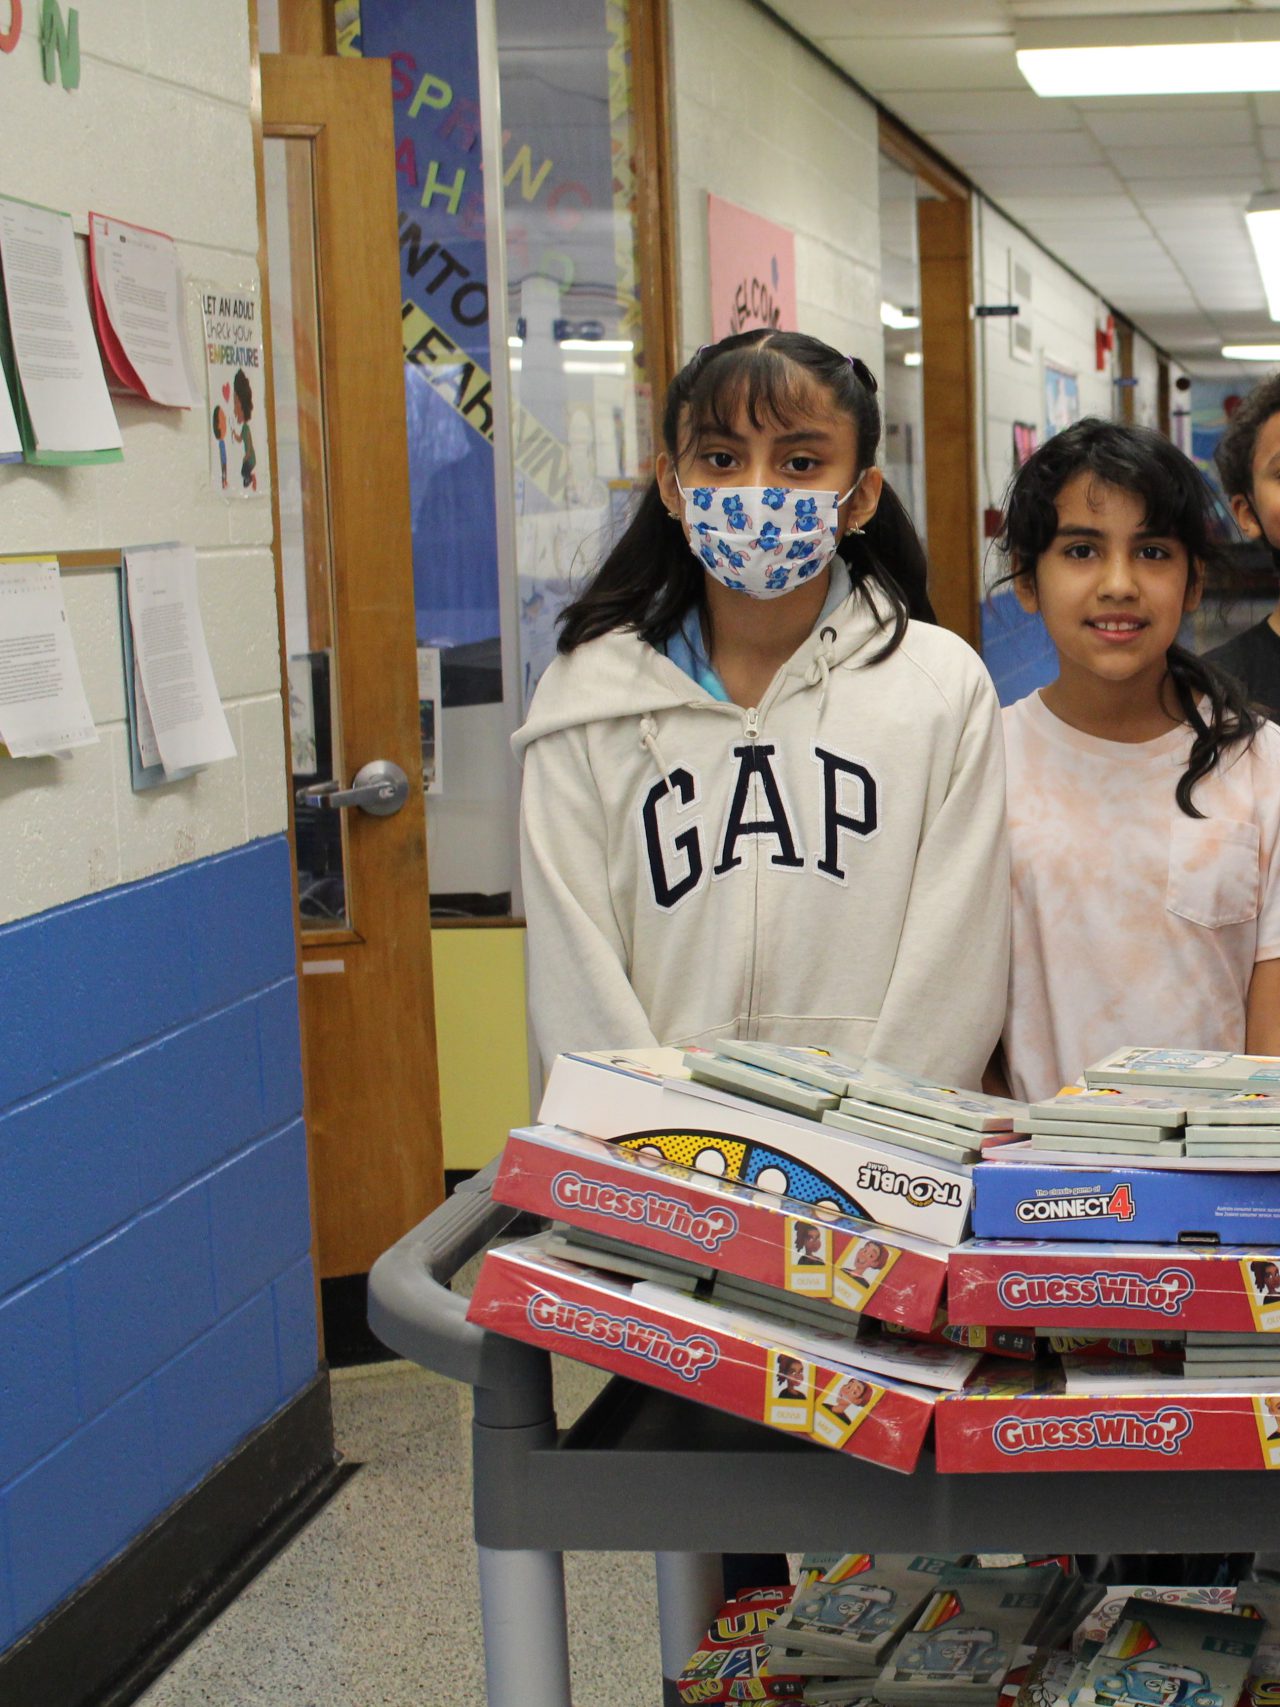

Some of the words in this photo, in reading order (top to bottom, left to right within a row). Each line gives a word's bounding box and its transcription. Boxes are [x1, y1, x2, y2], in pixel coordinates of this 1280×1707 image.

[203, 294, 216, 315] LET
[219, 296, 231, 317] AN
[233, 299, 255, 320] ADULT
[207, 343, 259, 368] TEMPERATURE
[642, 744, 878, 908] GAP
[867, 1162, 888, 1171] GAME
[858, 1166, 962, 1207] TROUBLE
[1019, 1197, 1109, 1220] CONNECT
[1108, 1186, 1132, 1219] 4
[555, 1174, 647, 1221] Guess
[646, 1195, 737, 1250] Who?
[1003, 1277, 1097, 1305] Guess
[1097, 1273, 1190, 1312] Who?
[532, 1296, 624, 1347] Guess
[624, 1319, 717, 1379] Who?
[999, 1421, 1094, 1450] Guess
[1094, 1411, 1188, 1451] Who?
[680, 1677, 723, 1704] UNO
